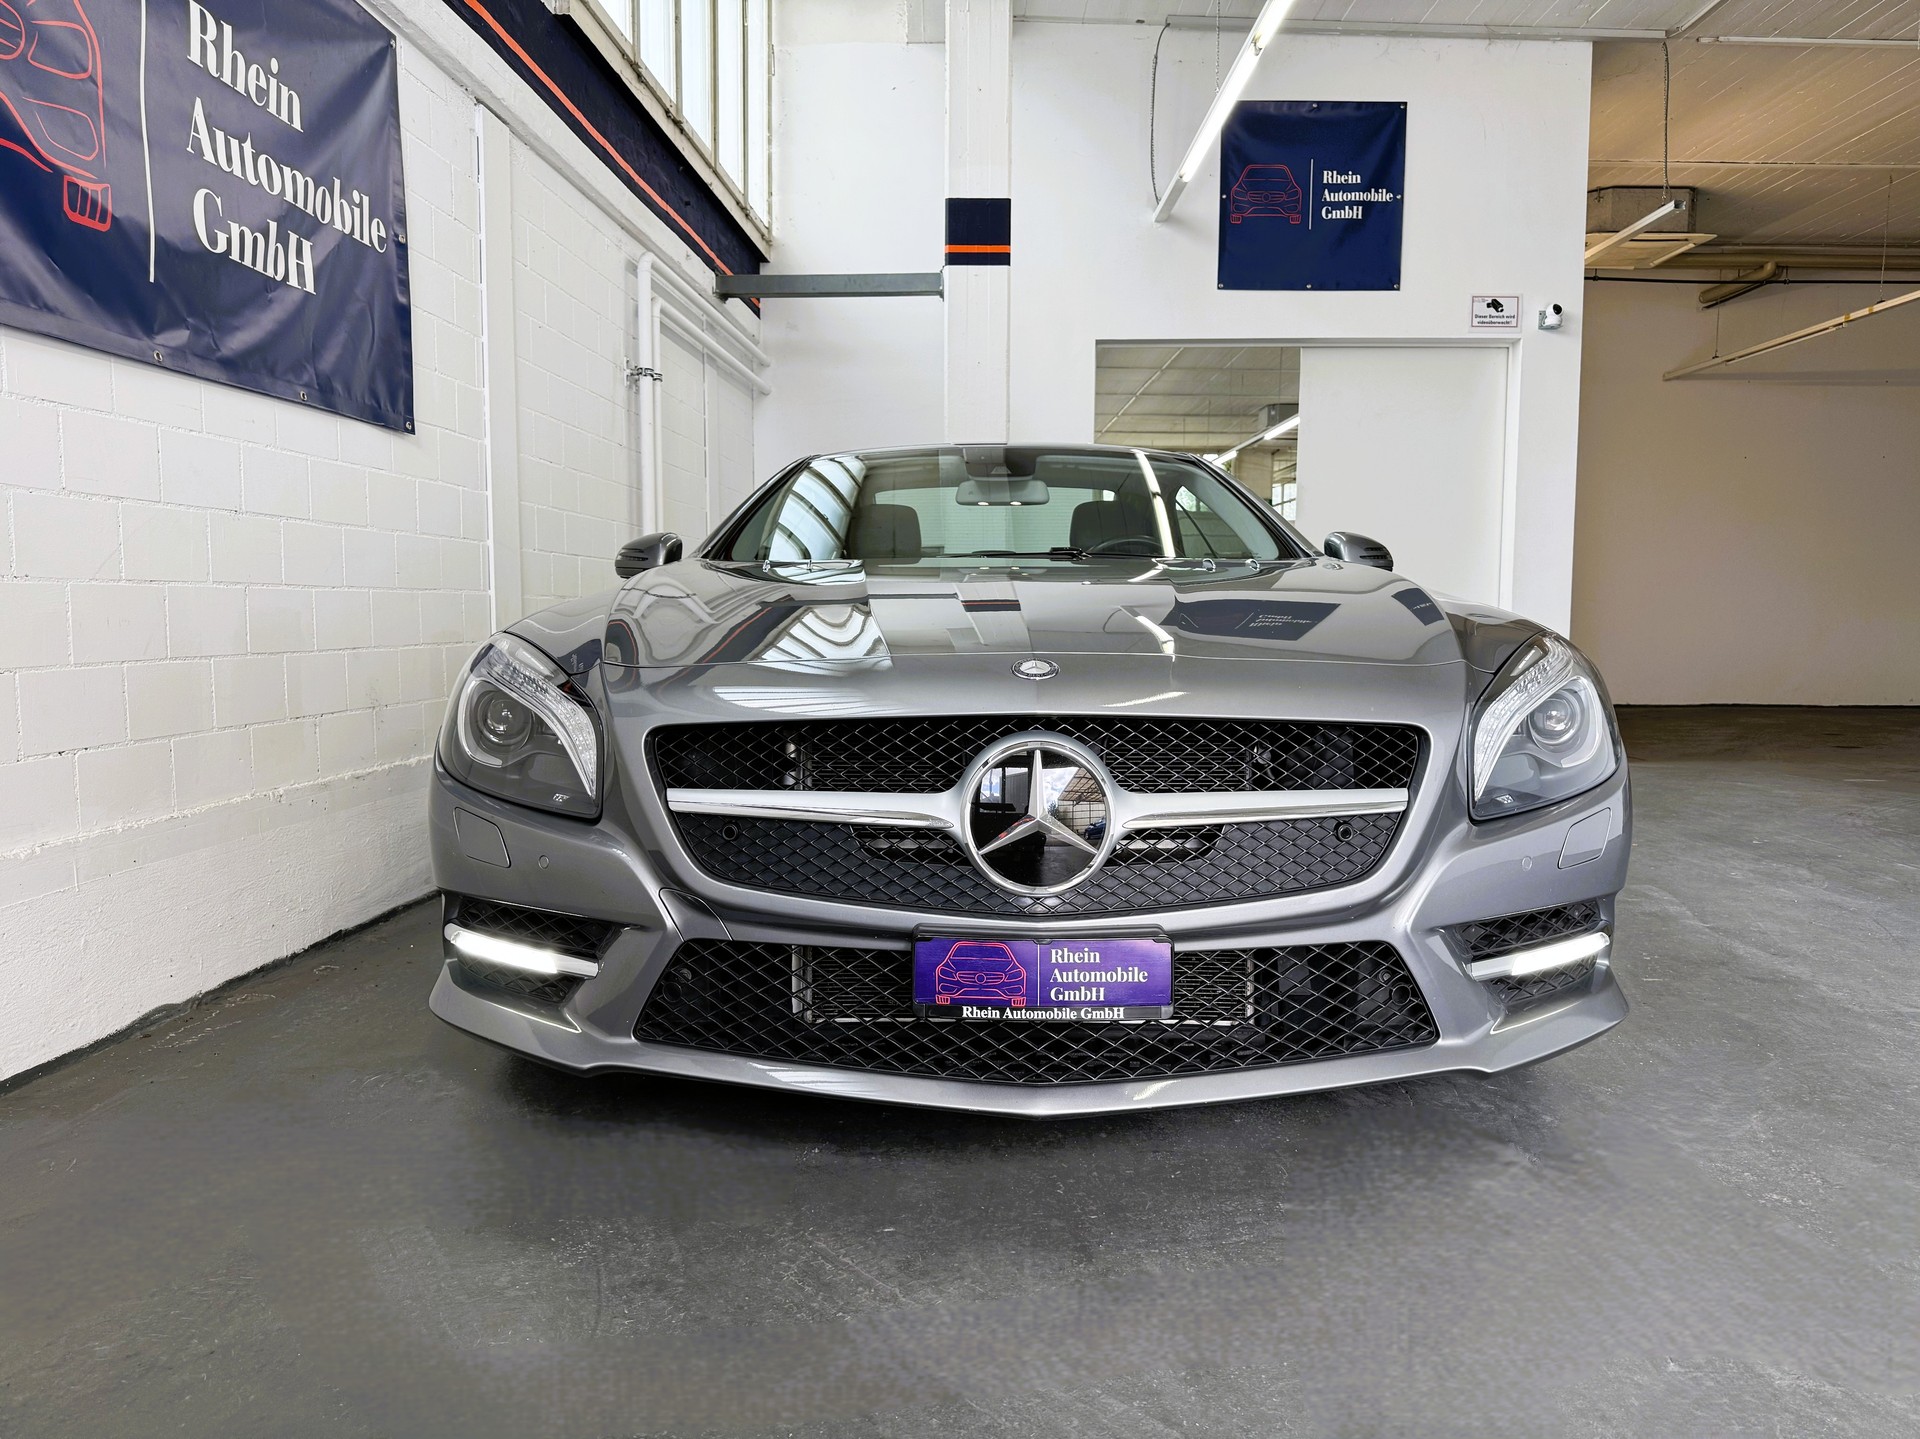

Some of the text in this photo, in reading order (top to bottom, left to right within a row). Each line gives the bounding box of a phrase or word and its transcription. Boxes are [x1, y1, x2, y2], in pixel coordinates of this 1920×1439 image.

[186, 0, 304, 133] Rhein
[187, 96, 388, 254] Automobile
[1322, 170, 1361, 184] Rhein
[1321, 188, 1394, 203] Automobile
[1321, 205, 1363, 220] GmbH
[193, 187, 317, 295] GmbH
[1050, 948, 1101, 964] Rhein
[1050, 967, 1148, 983] Automobile
[1050, 986, 1105, 1002] GmbH
[962, 1005, 1125, 1020] Rhein Automobile GmbH
